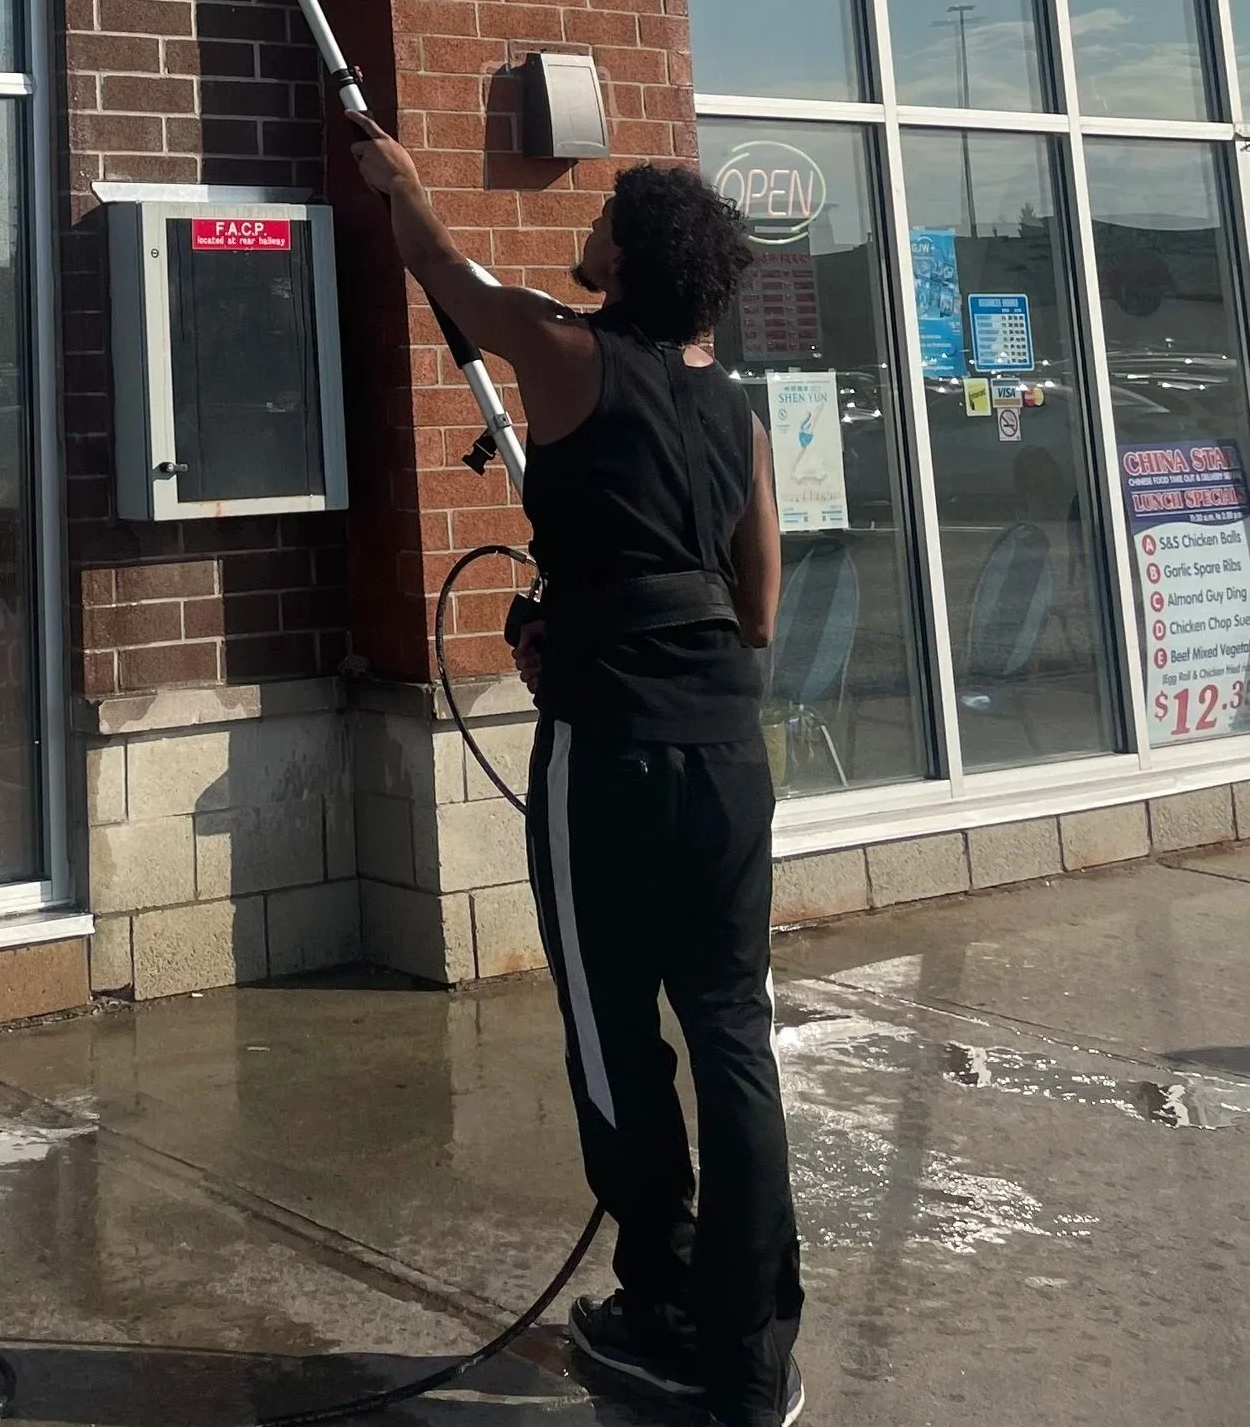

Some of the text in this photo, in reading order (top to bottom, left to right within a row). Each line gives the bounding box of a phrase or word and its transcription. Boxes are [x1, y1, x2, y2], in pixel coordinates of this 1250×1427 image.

[720, 169, 814, 218] OPEN
[215, 221, 268, 237] F.A.C.P.
[197, 235, 286, 247] located at rear hallway
[778, 392, 828, 404] SHEN YUN
[998, 387, 1016, 398] VISA
[1123, 449, 1190, 476] CHINA
[1153, 475, 1169, 485] FOOD
[1132, 491, 1184, 512] LUNCH
[1159, 536, 1179, 550] S&S
[1182, 532, 1218, 548] Chicken
[1220, 530, 1241, 545] Balls
[1164, 563, 1192, 579] Garlic
[1193, 562, 1221, 578] Spare
[1223, 558, 1241, 572] Ribs
[1167, 590, 1204, 607] Almond
[1205, 589, 1224, 605] Guy
[1226, 585, 1248, 603] Ding
[1170, 619, 1206, 635] Chicken
[1208, 615, 1232, 632] Chop
[1170, 647, 1191, 663] Beef
[1192, 643, 1218, 660] Mixed
